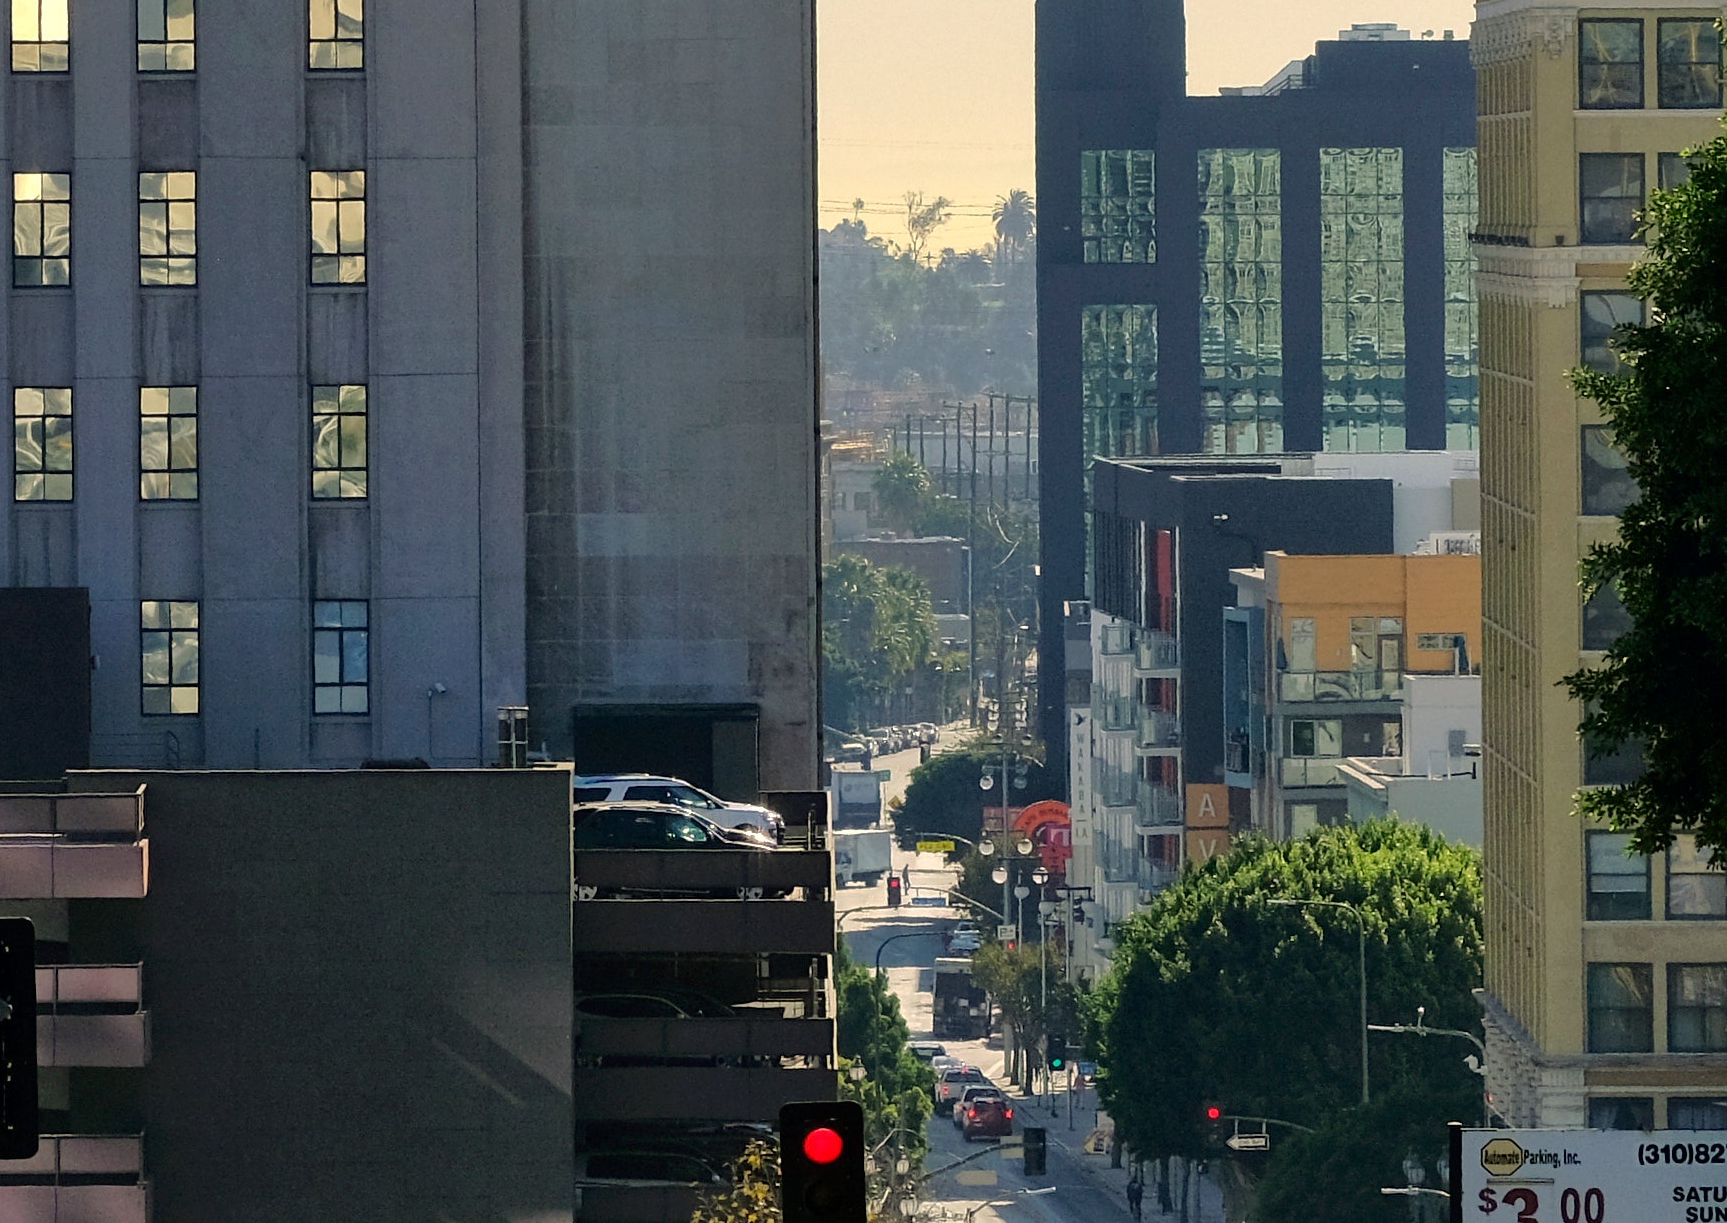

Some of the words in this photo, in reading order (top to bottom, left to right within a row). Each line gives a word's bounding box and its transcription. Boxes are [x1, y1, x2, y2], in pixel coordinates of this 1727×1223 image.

[1523, 1149, 1562, 1169] Parking,
[1563, 1149, 1582, 1165] Inc.
[1638, 1143, 1727, 1166] (310)82
